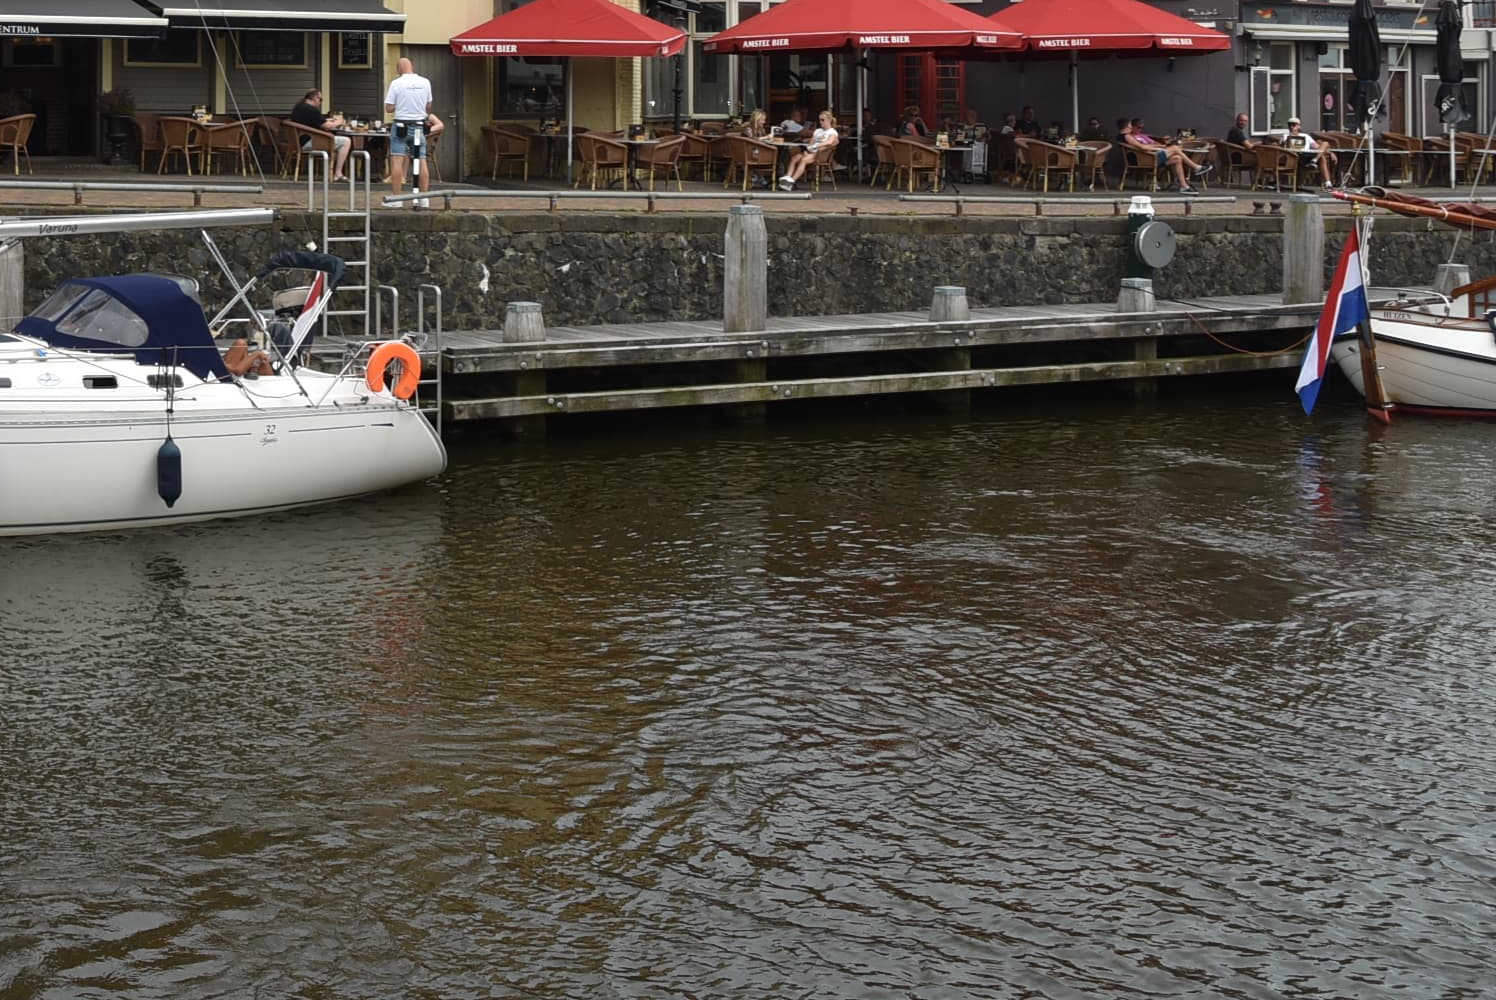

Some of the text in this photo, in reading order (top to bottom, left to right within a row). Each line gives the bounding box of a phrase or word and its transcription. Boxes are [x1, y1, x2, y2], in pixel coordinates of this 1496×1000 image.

[743, 38, 790, 48] AMSTEL BIER
[859, 35, 910, 44] AMSTEL BIER
[1039, 38, 1091, 47] AMSTEL BIER
[461, 44, 518, 53] AMSTEL BIER
[39, 223, 79, 234] Varuna
